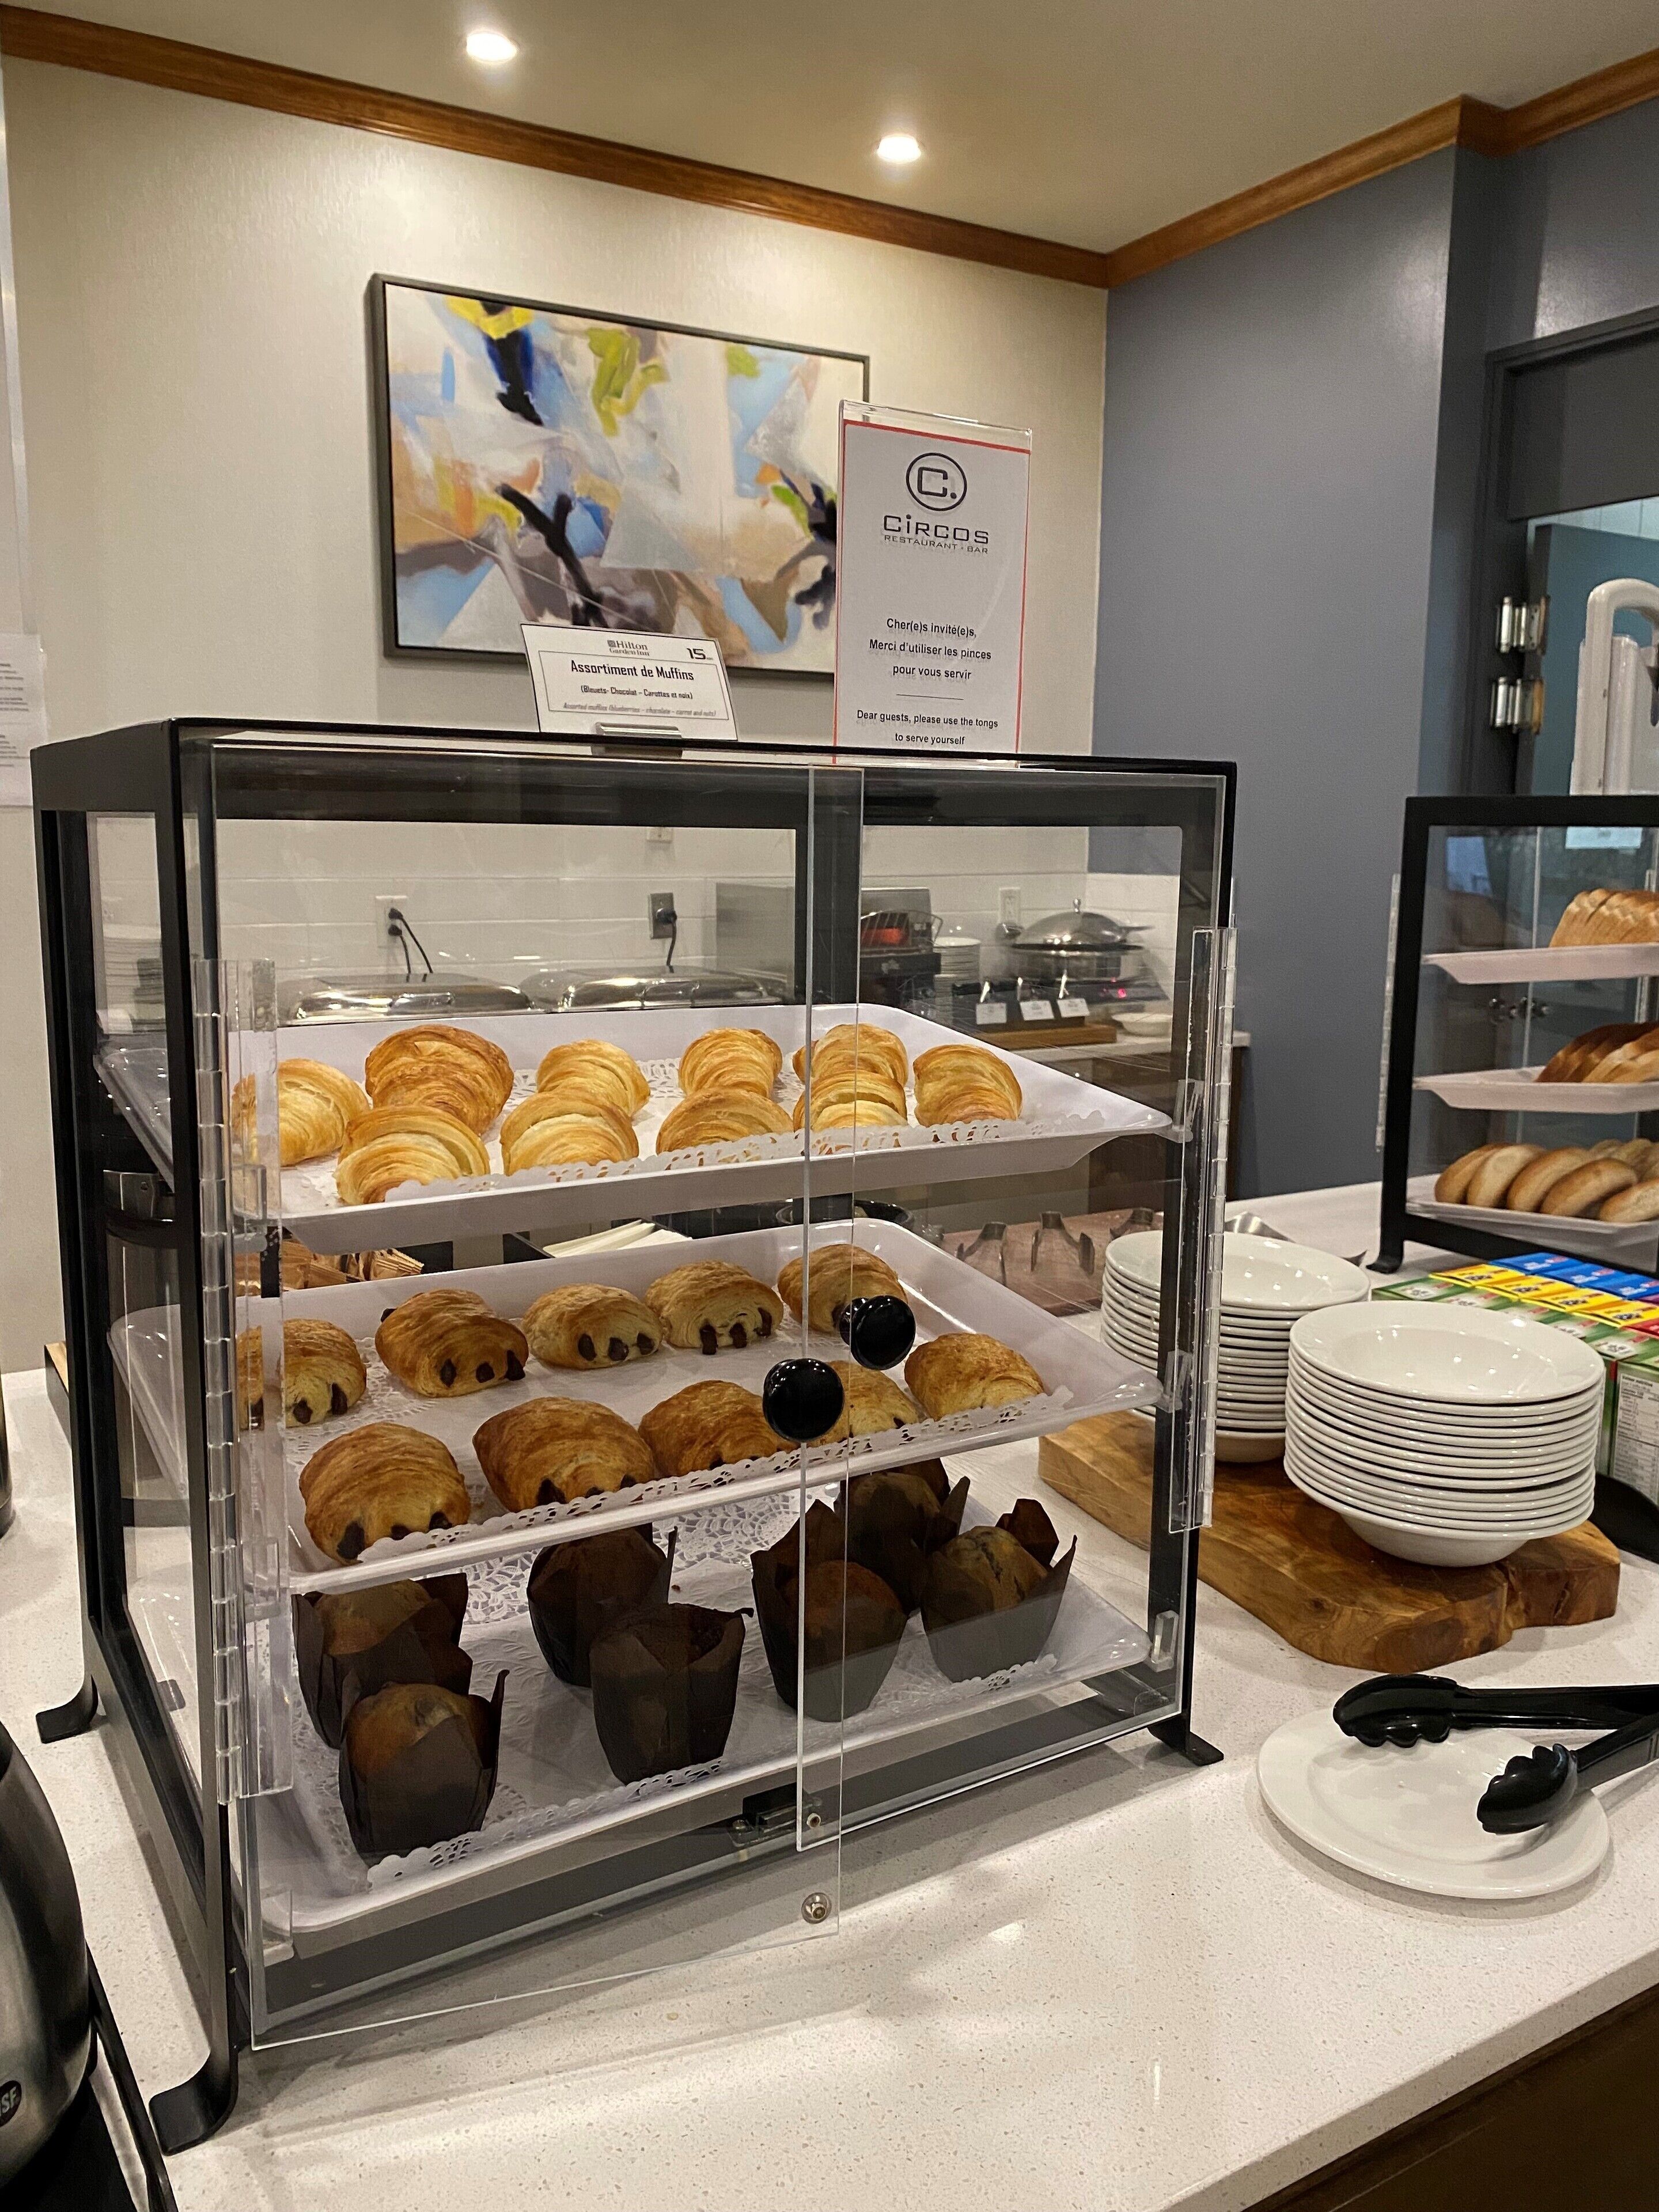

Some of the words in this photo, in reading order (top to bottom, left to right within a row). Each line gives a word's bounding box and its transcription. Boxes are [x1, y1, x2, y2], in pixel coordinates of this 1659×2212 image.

[884, 535, 957, 550] RESTAURANT
[967, 546, 988, 554] BAR
[887, 618, 927, 633] Cher(e)s
[931, 623, 976, 638] invité(e)s,
[616, 640, 648, 650] Hilton
[687, 647, 706, 660] 15
[869, 639, 896, 650] Merci
[900, 642, 942, 654] d'utiliser
[944, 646, 957, 656] les
[961, 648, 991, 659] pinces
[571, 660, 638, 676] Assortiment
[641, 665, 654, 677] de
[656, 666, 694, 680] Muffins
[893, 666, 915, 676] pour
[919, 668, 941, 677] vous
[944, 669, 971, 679] servir
[857, 710, 877, 719] Dear
[880, 713, 911, 723] guests,
[914, 714, 941, 724] please
[960, 717, 973, 726] the
[975, 718, 998, 729] tongs
[895, 733, 903, 741] to
[906, 734, 929, 743] serve
[931, 736, 965, 745] yourself
